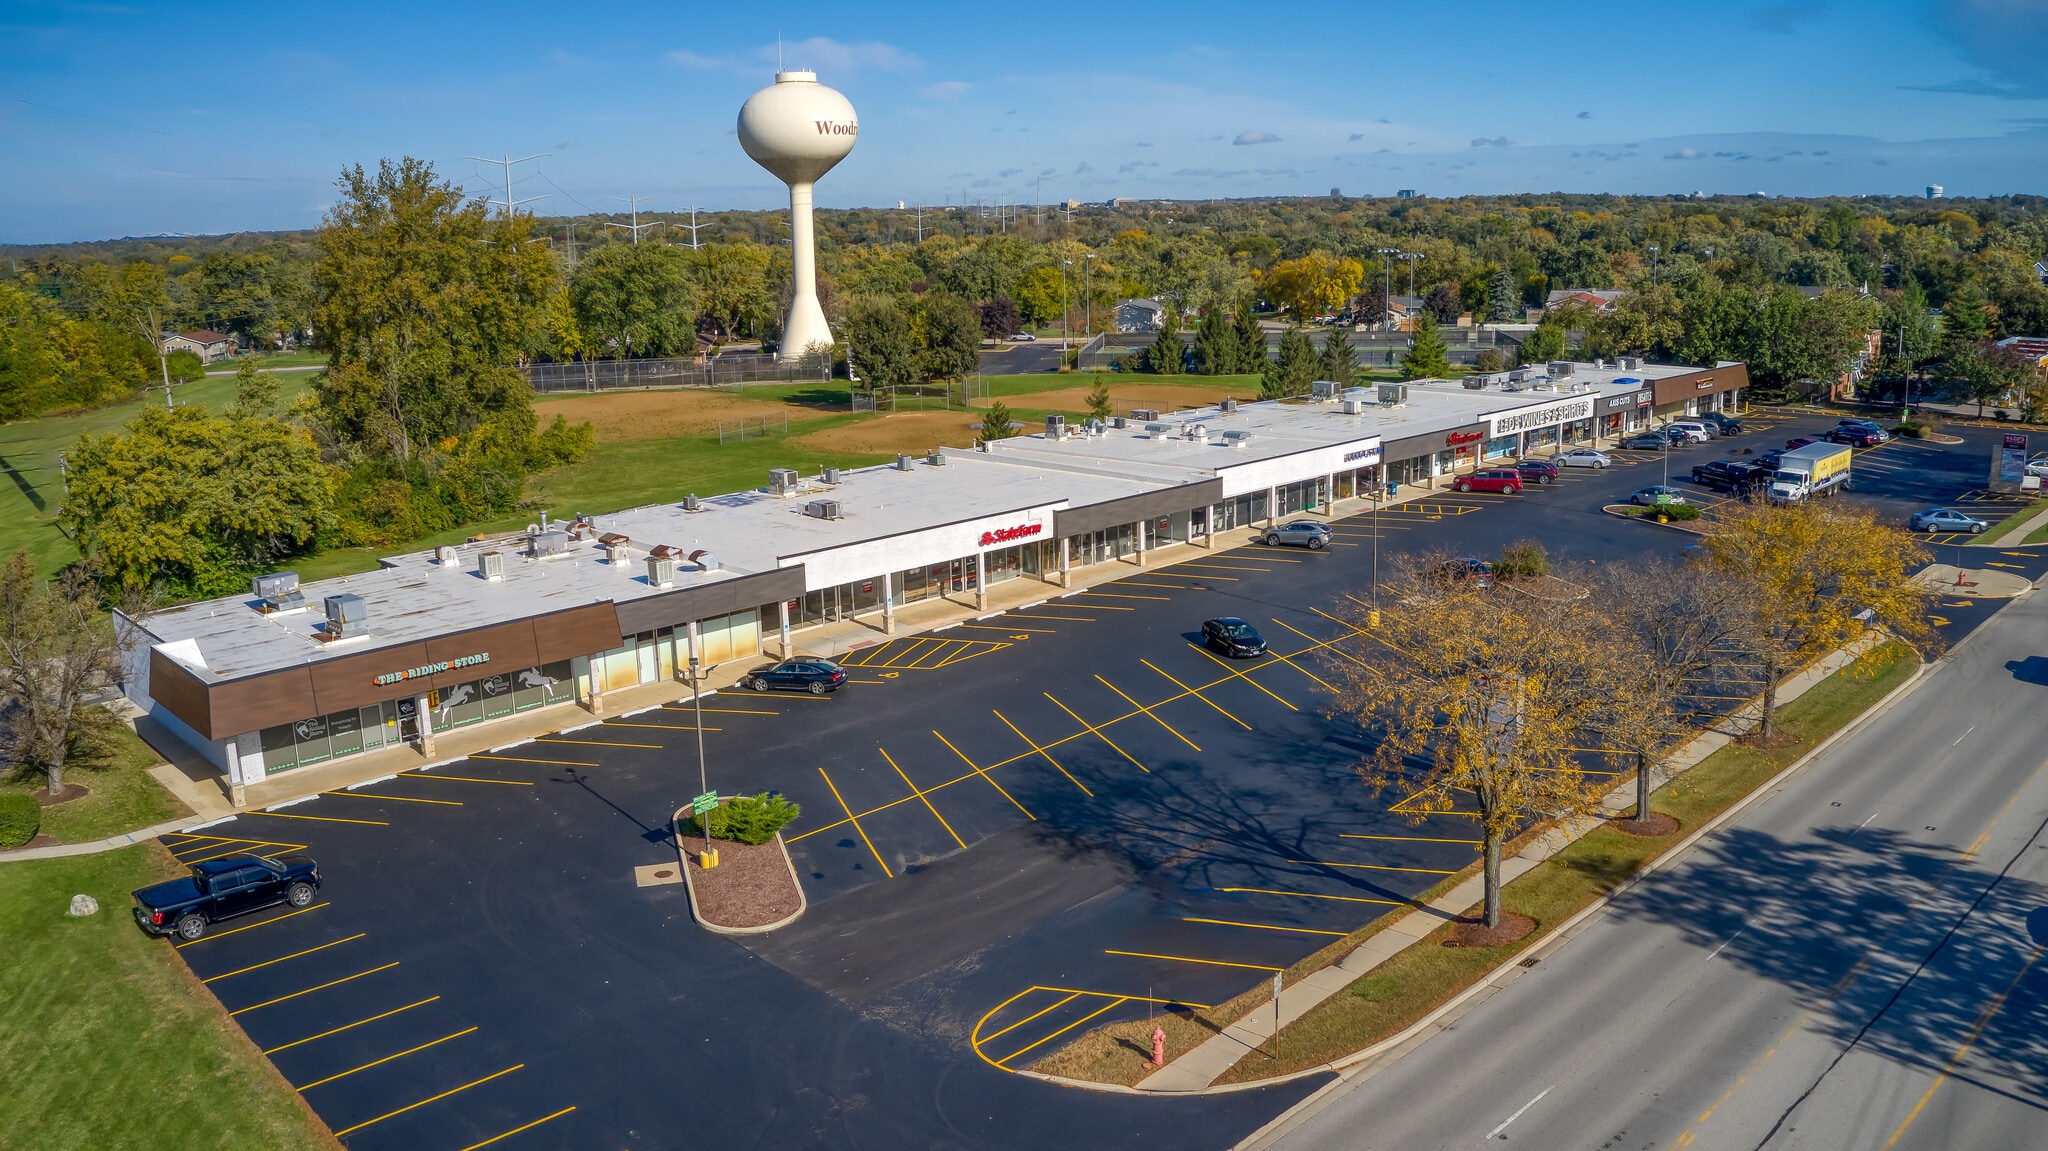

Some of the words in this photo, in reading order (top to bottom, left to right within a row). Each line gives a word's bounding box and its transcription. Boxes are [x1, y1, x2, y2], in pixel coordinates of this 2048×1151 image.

[1520, 409, 1551, 429] WINES
[1559, 401, 1588, 421] SPIRITS
[377, 671, 402, 685] THE
[408, 661, 448, 679] RIDING
[454, 652, 490, 668] STORE
[428, 691, 439, 709] LE
